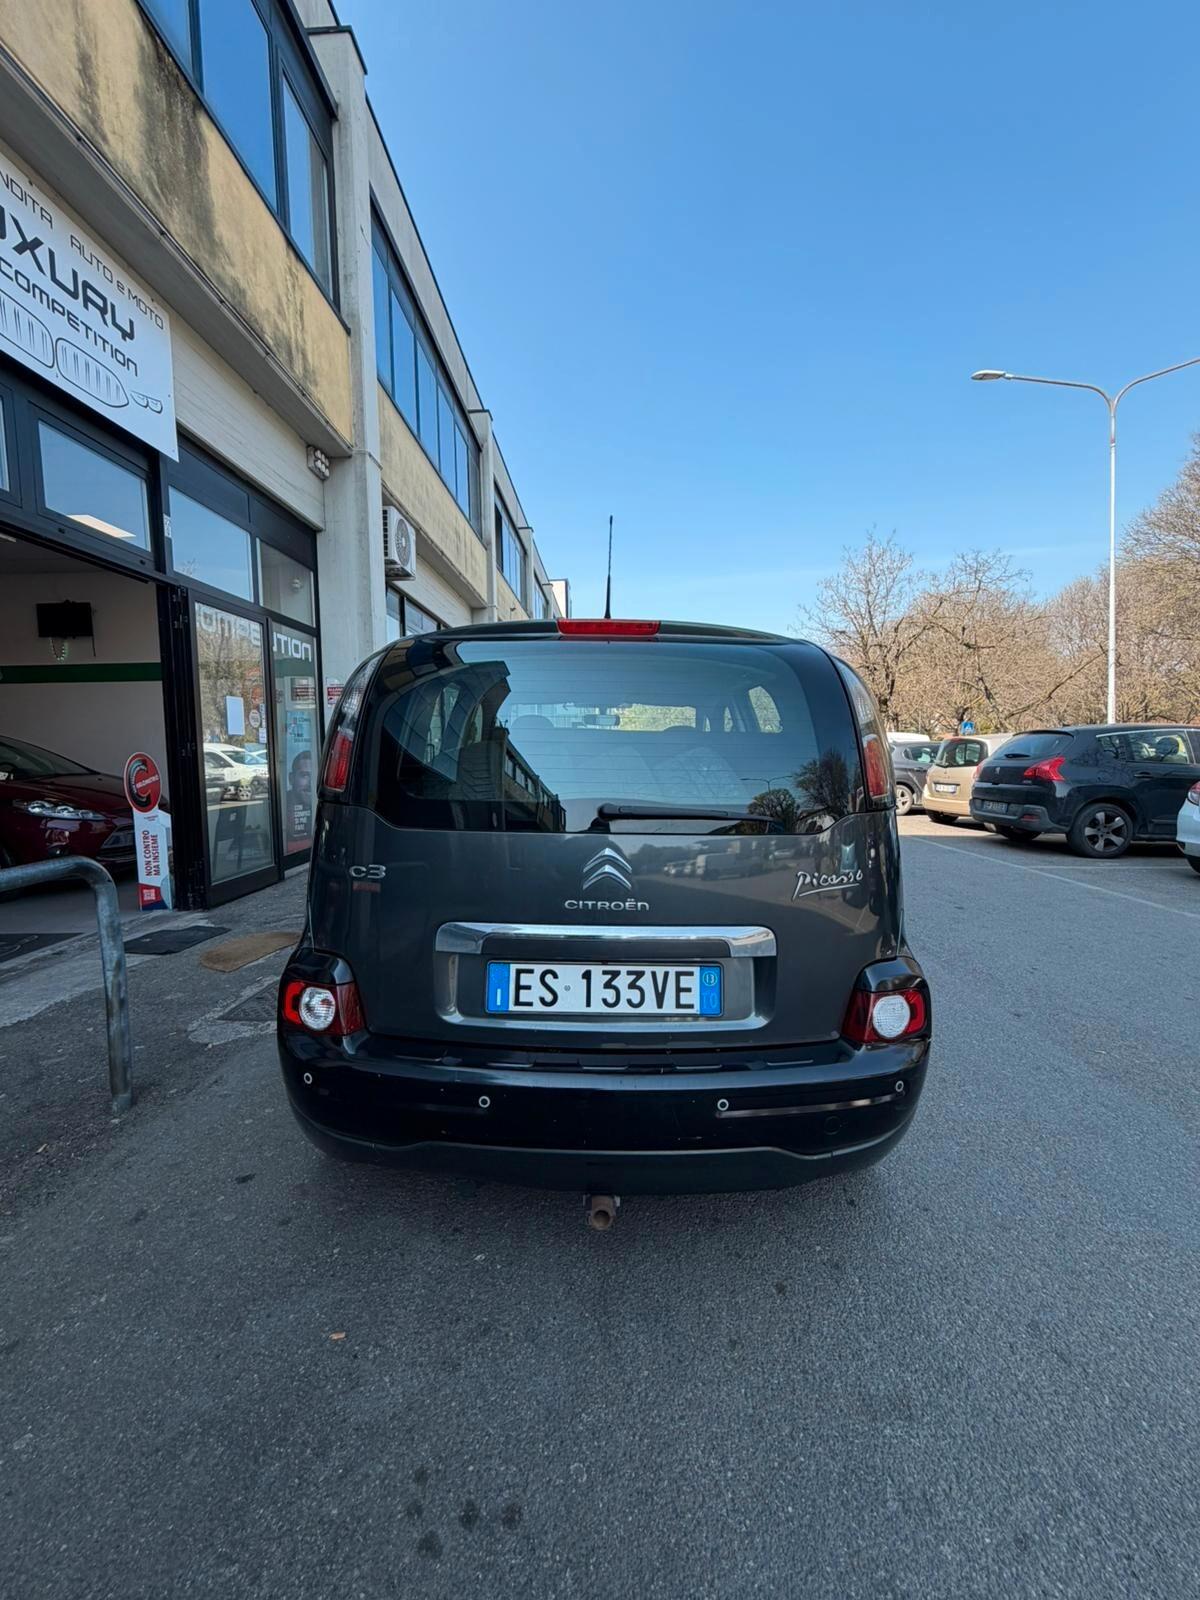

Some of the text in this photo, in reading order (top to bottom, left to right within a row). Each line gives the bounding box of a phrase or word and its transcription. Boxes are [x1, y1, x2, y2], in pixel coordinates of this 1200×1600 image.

[70, 234, 114, 284] AUTO
[128, 287, 164, 330] MOTO
[142, 830, 152, 859] CONTRO
[151, 834, 161, 876] MA INSIEME
[145, 860, 153, 876] NON
[349, 864, 386, 879] C3
[791, 868, 864, 902] Picasso
[513, 968, 559, 1007] ES
[581, 969, 695, 1009] 133VE
